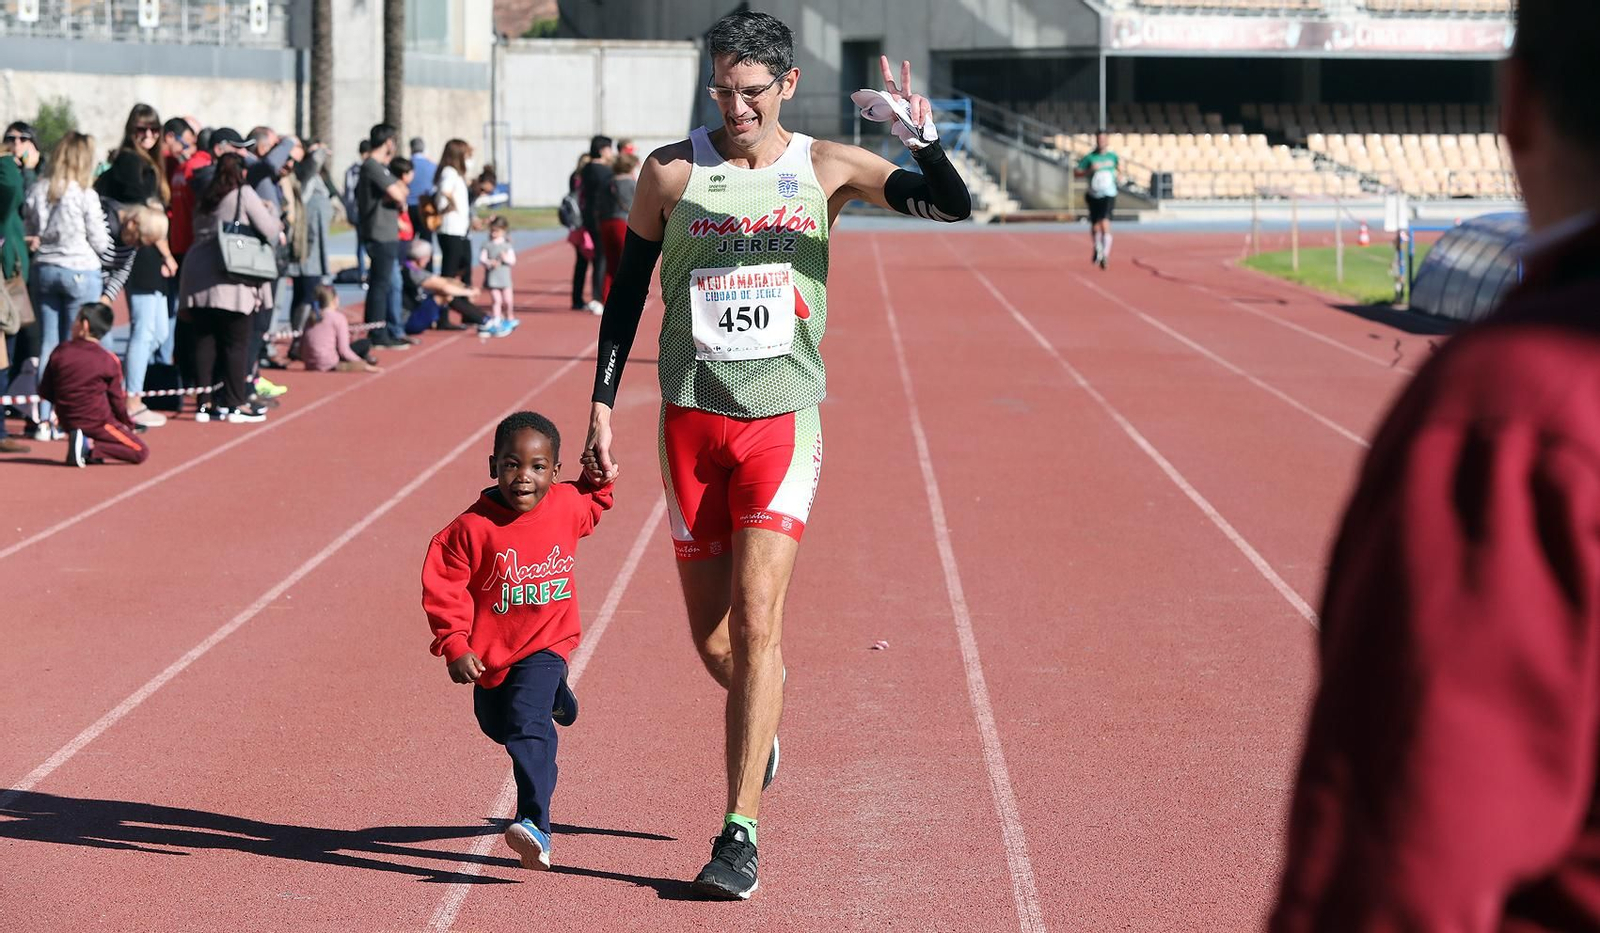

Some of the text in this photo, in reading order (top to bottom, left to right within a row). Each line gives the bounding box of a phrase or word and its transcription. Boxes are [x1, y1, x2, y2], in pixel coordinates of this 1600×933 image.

[689, 205, 817, 236] maratón
[717, 239, 797, 253] JEREZ
[705, 290, 738, 302] CIUDAD
[740, 289, 752, 300] DE
[718, 304, 770, 332] 450
